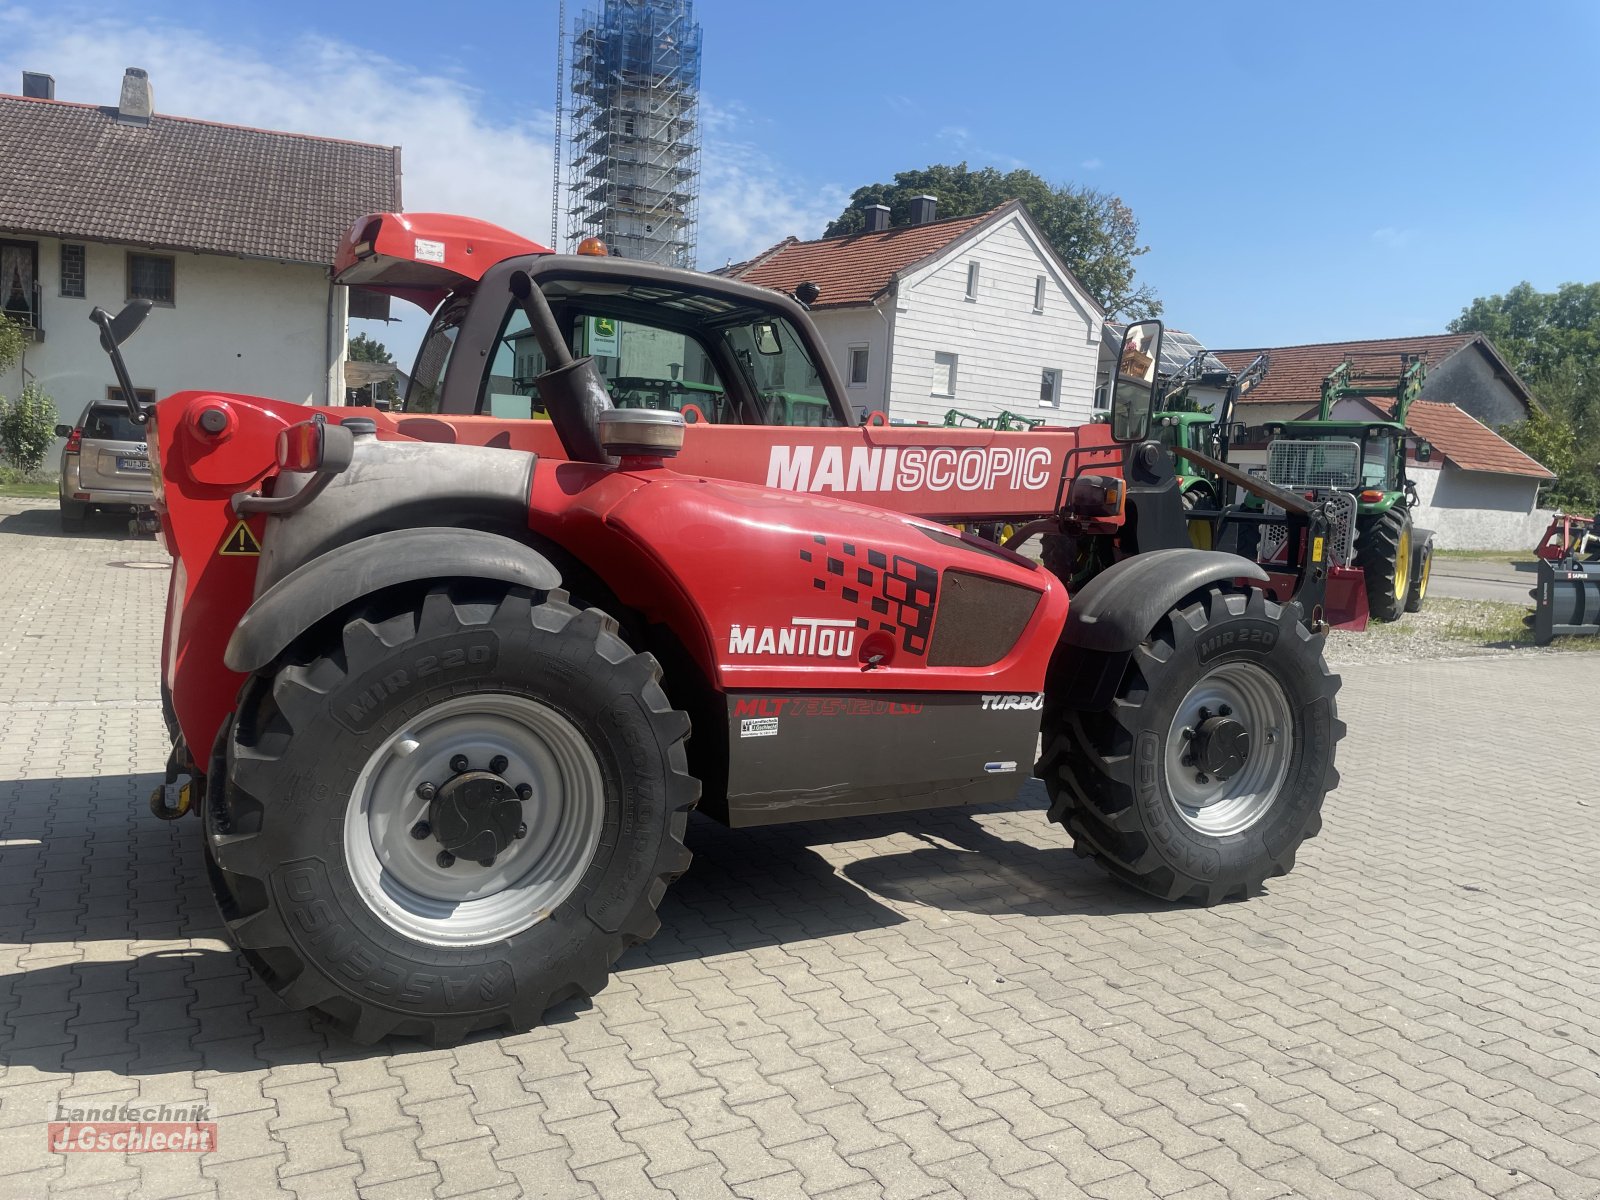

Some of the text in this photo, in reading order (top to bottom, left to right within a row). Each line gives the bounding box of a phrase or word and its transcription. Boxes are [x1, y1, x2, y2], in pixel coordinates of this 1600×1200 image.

[766, 445, 1052, 491] MANISCOPIC
[728, 616, 856, 657] MANITOU
[1201, 628, 1274, 656] MIR 220
[345, 669, 411, 722] MIR
[414, 645, 491, 678] 220
[981, 693, 1044, 711] TURBO
[734, 697, 789, 717] MLT
[1140, 737, 1201, 868] ASCENSO
[284, 867, 478, 1007] ASCENSO
